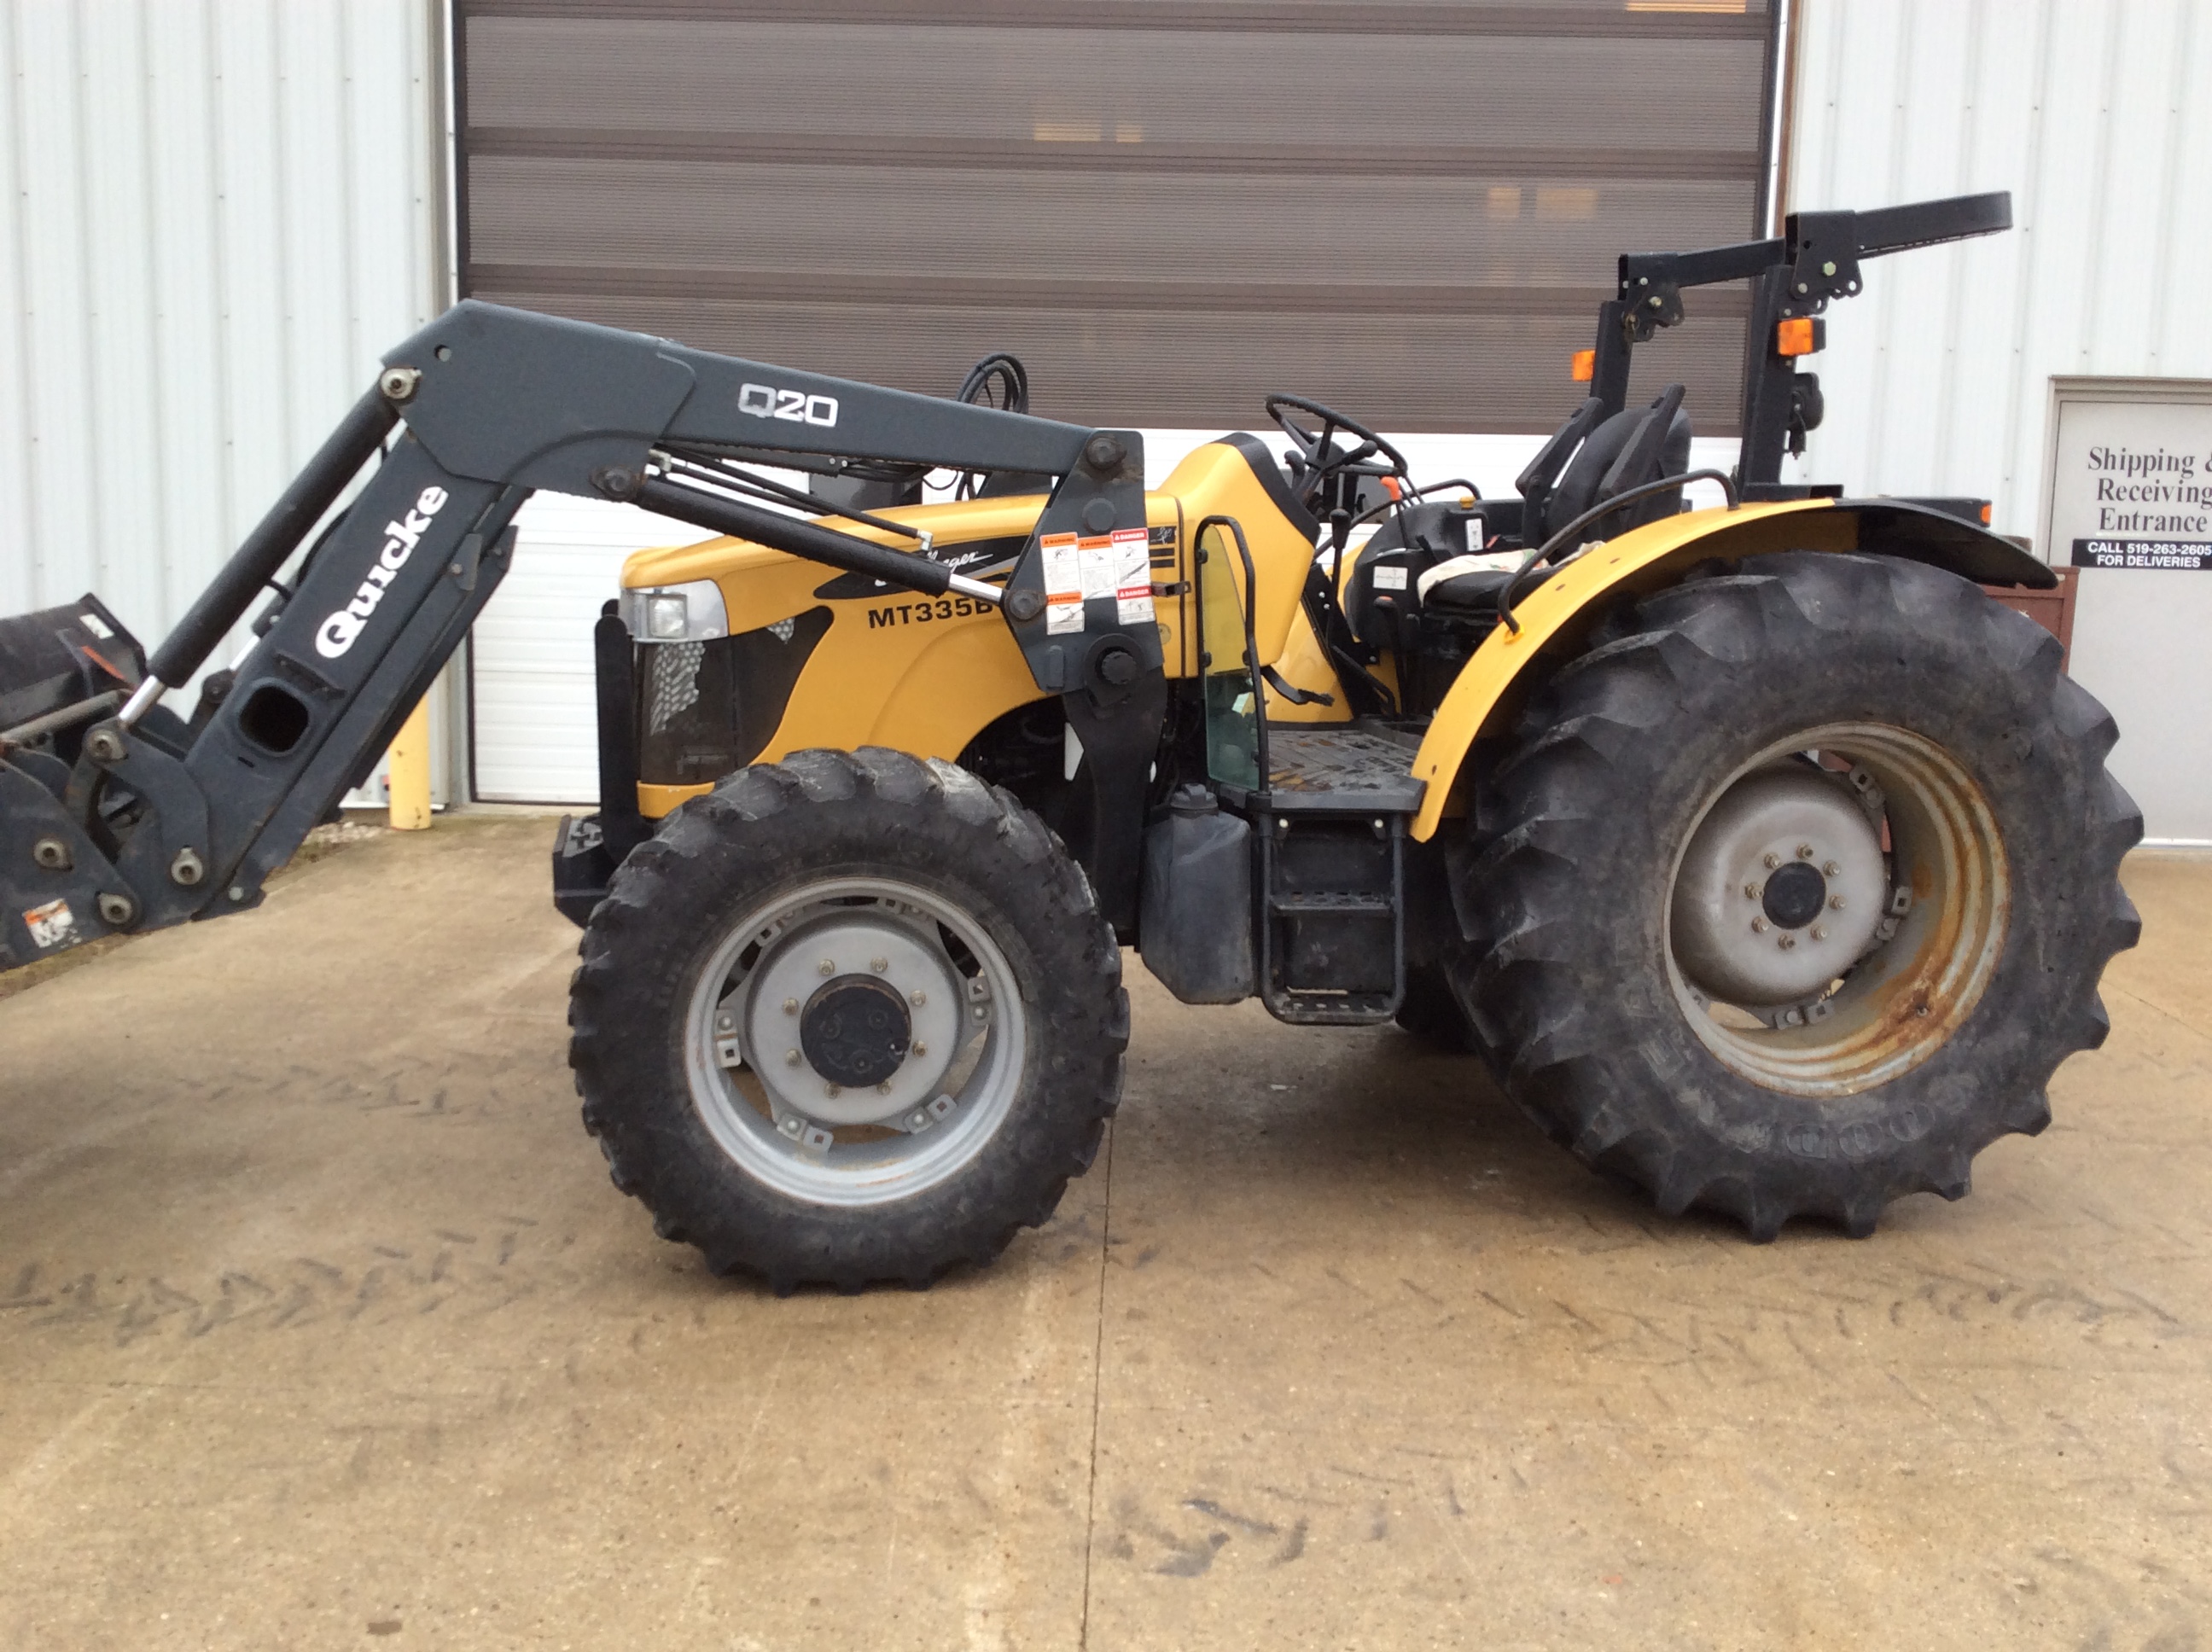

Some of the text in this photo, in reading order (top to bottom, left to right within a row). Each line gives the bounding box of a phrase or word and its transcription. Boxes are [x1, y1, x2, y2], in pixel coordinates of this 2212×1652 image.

[737, 382, 839, 428] Q20
[2087, 446, 2196, 479] Shipping
[2097, 477, 2212, 509] Receiving
[2099, 507, 2208, 532] Entrance
[1120, 532, 1145, 540] DANGER
[2087, 541, 2212, 556] CALL 519-263-2605
[315, 486, 449, 659] Quicke
[2097, 555, 2201, 568] FOR DELIVERIES
[1125, 588, 1150, 596] DANGER
